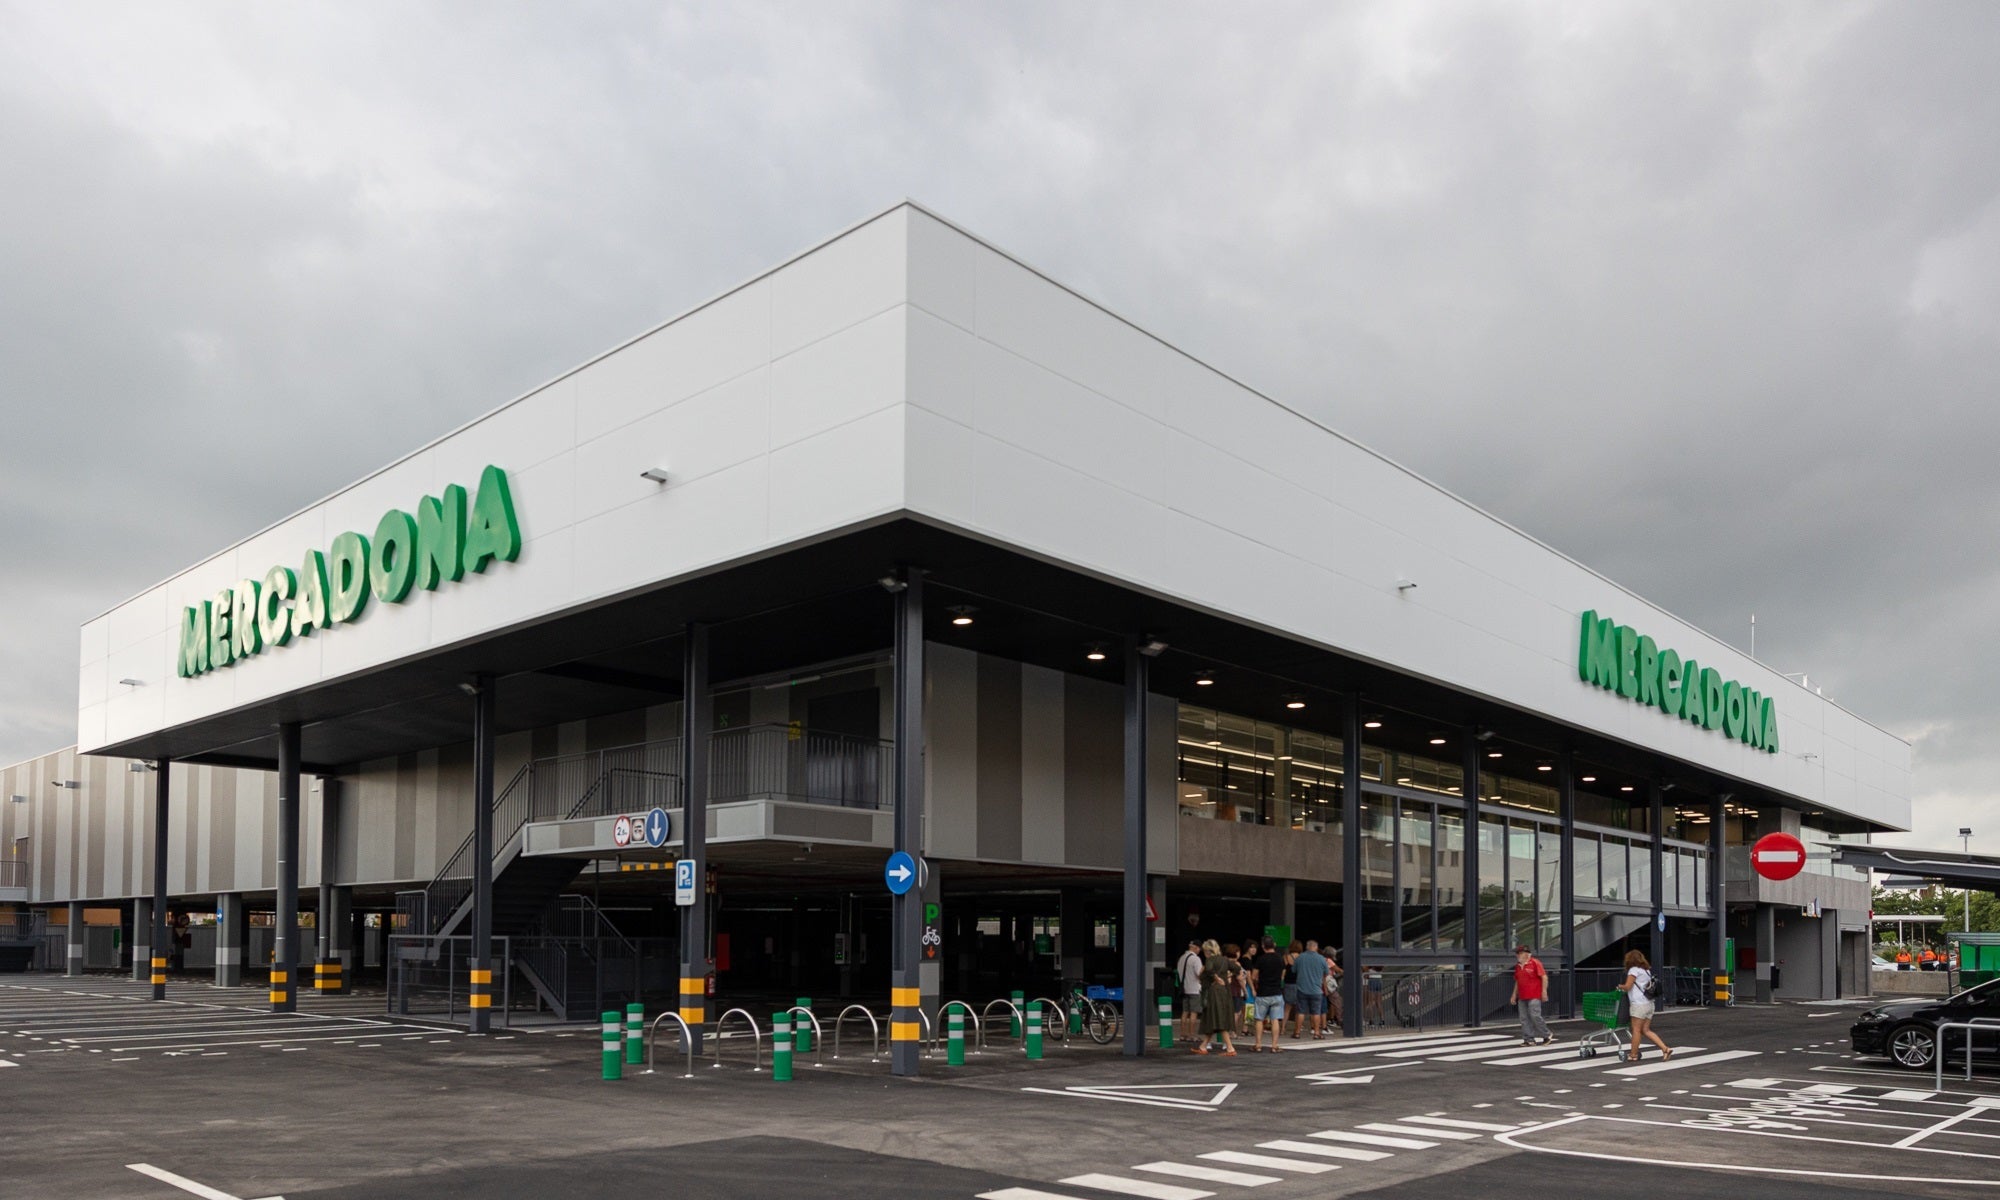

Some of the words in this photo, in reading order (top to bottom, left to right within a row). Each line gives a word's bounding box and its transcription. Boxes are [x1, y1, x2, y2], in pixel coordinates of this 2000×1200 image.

[178, 464, 523, 678] MERCADONA
[1578, 608, 1779, 753] MERCADONA
[679, 865, 690, 887] P
[925, 903, 939, 925] P
